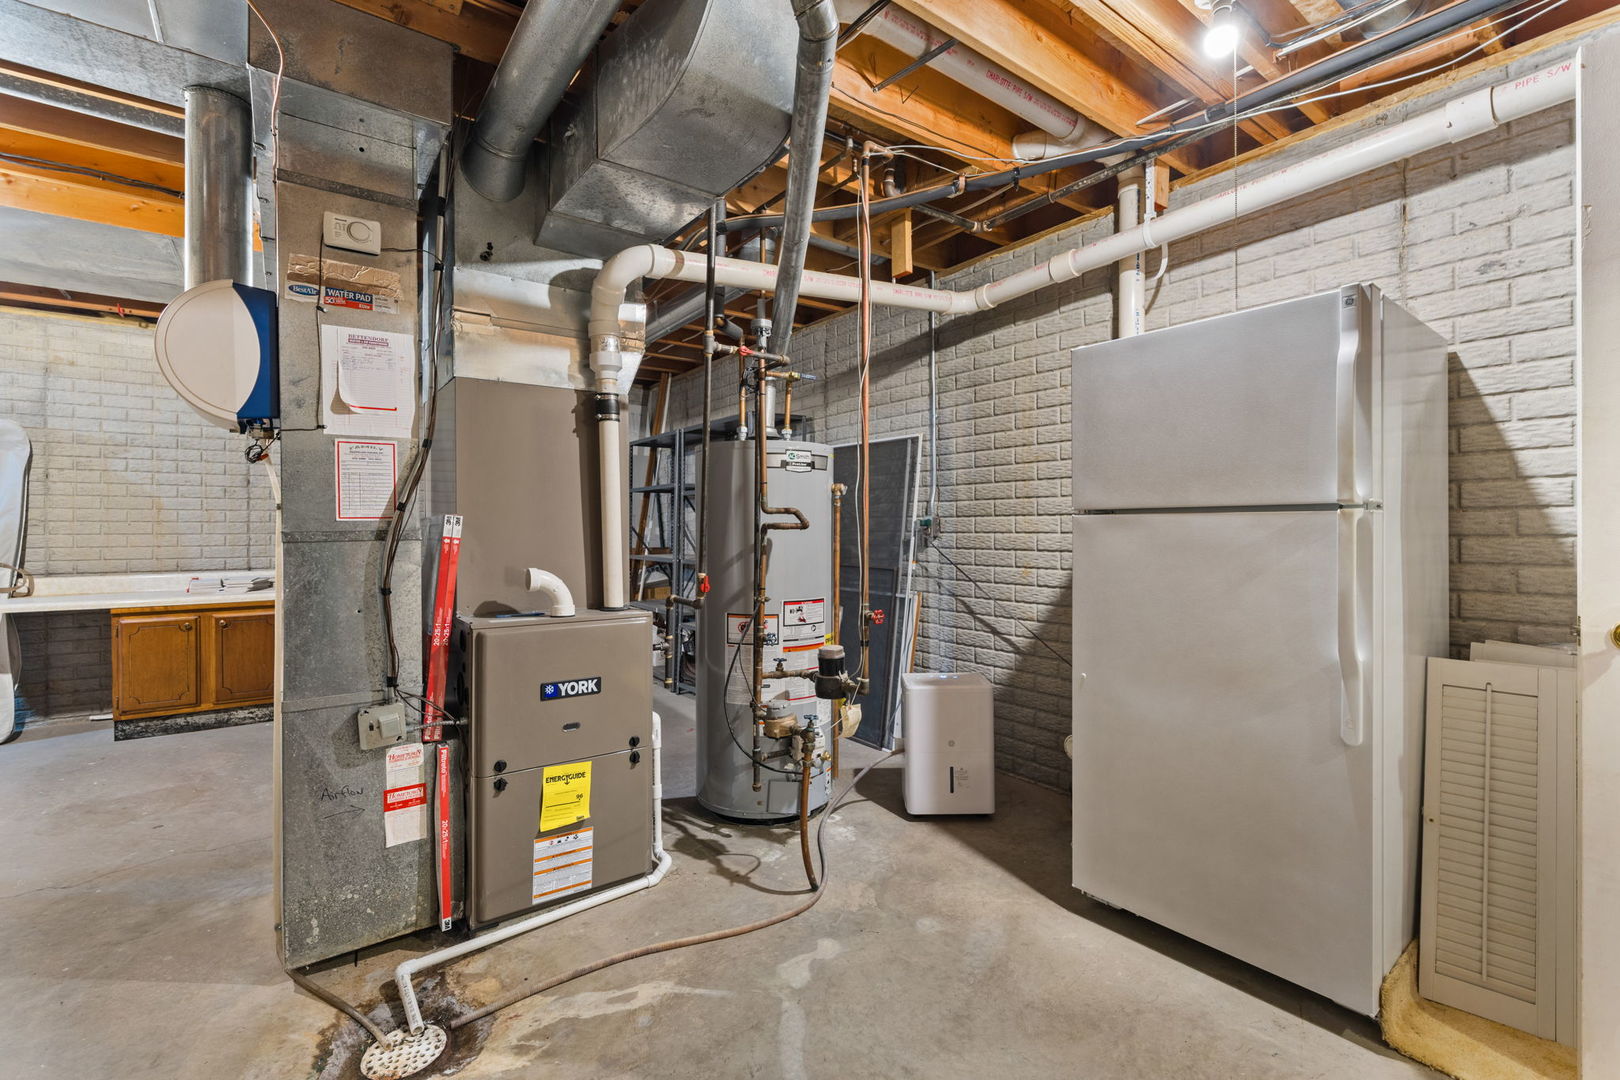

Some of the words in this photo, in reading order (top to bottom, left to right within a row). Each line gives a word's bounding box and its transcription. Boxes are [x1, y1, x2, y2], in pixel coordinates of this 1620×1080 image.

[986, 70, 1012, 90] CHARLOTTE
[1515, 74, 1540, 89] PIPE
[1547, 62, 1572, 78] S/W
[327, 288, 355, 300] WATER
[355, 294, 371, 303] PAD
[348, 333, 389, 343] BETTENDORF
[454, 516, 461, 527] 3M
[558, 679, 598, 696] YORK
[387, 749, 422, 761] HOMETOWN
[321, 784, 364, 801] Airflow
